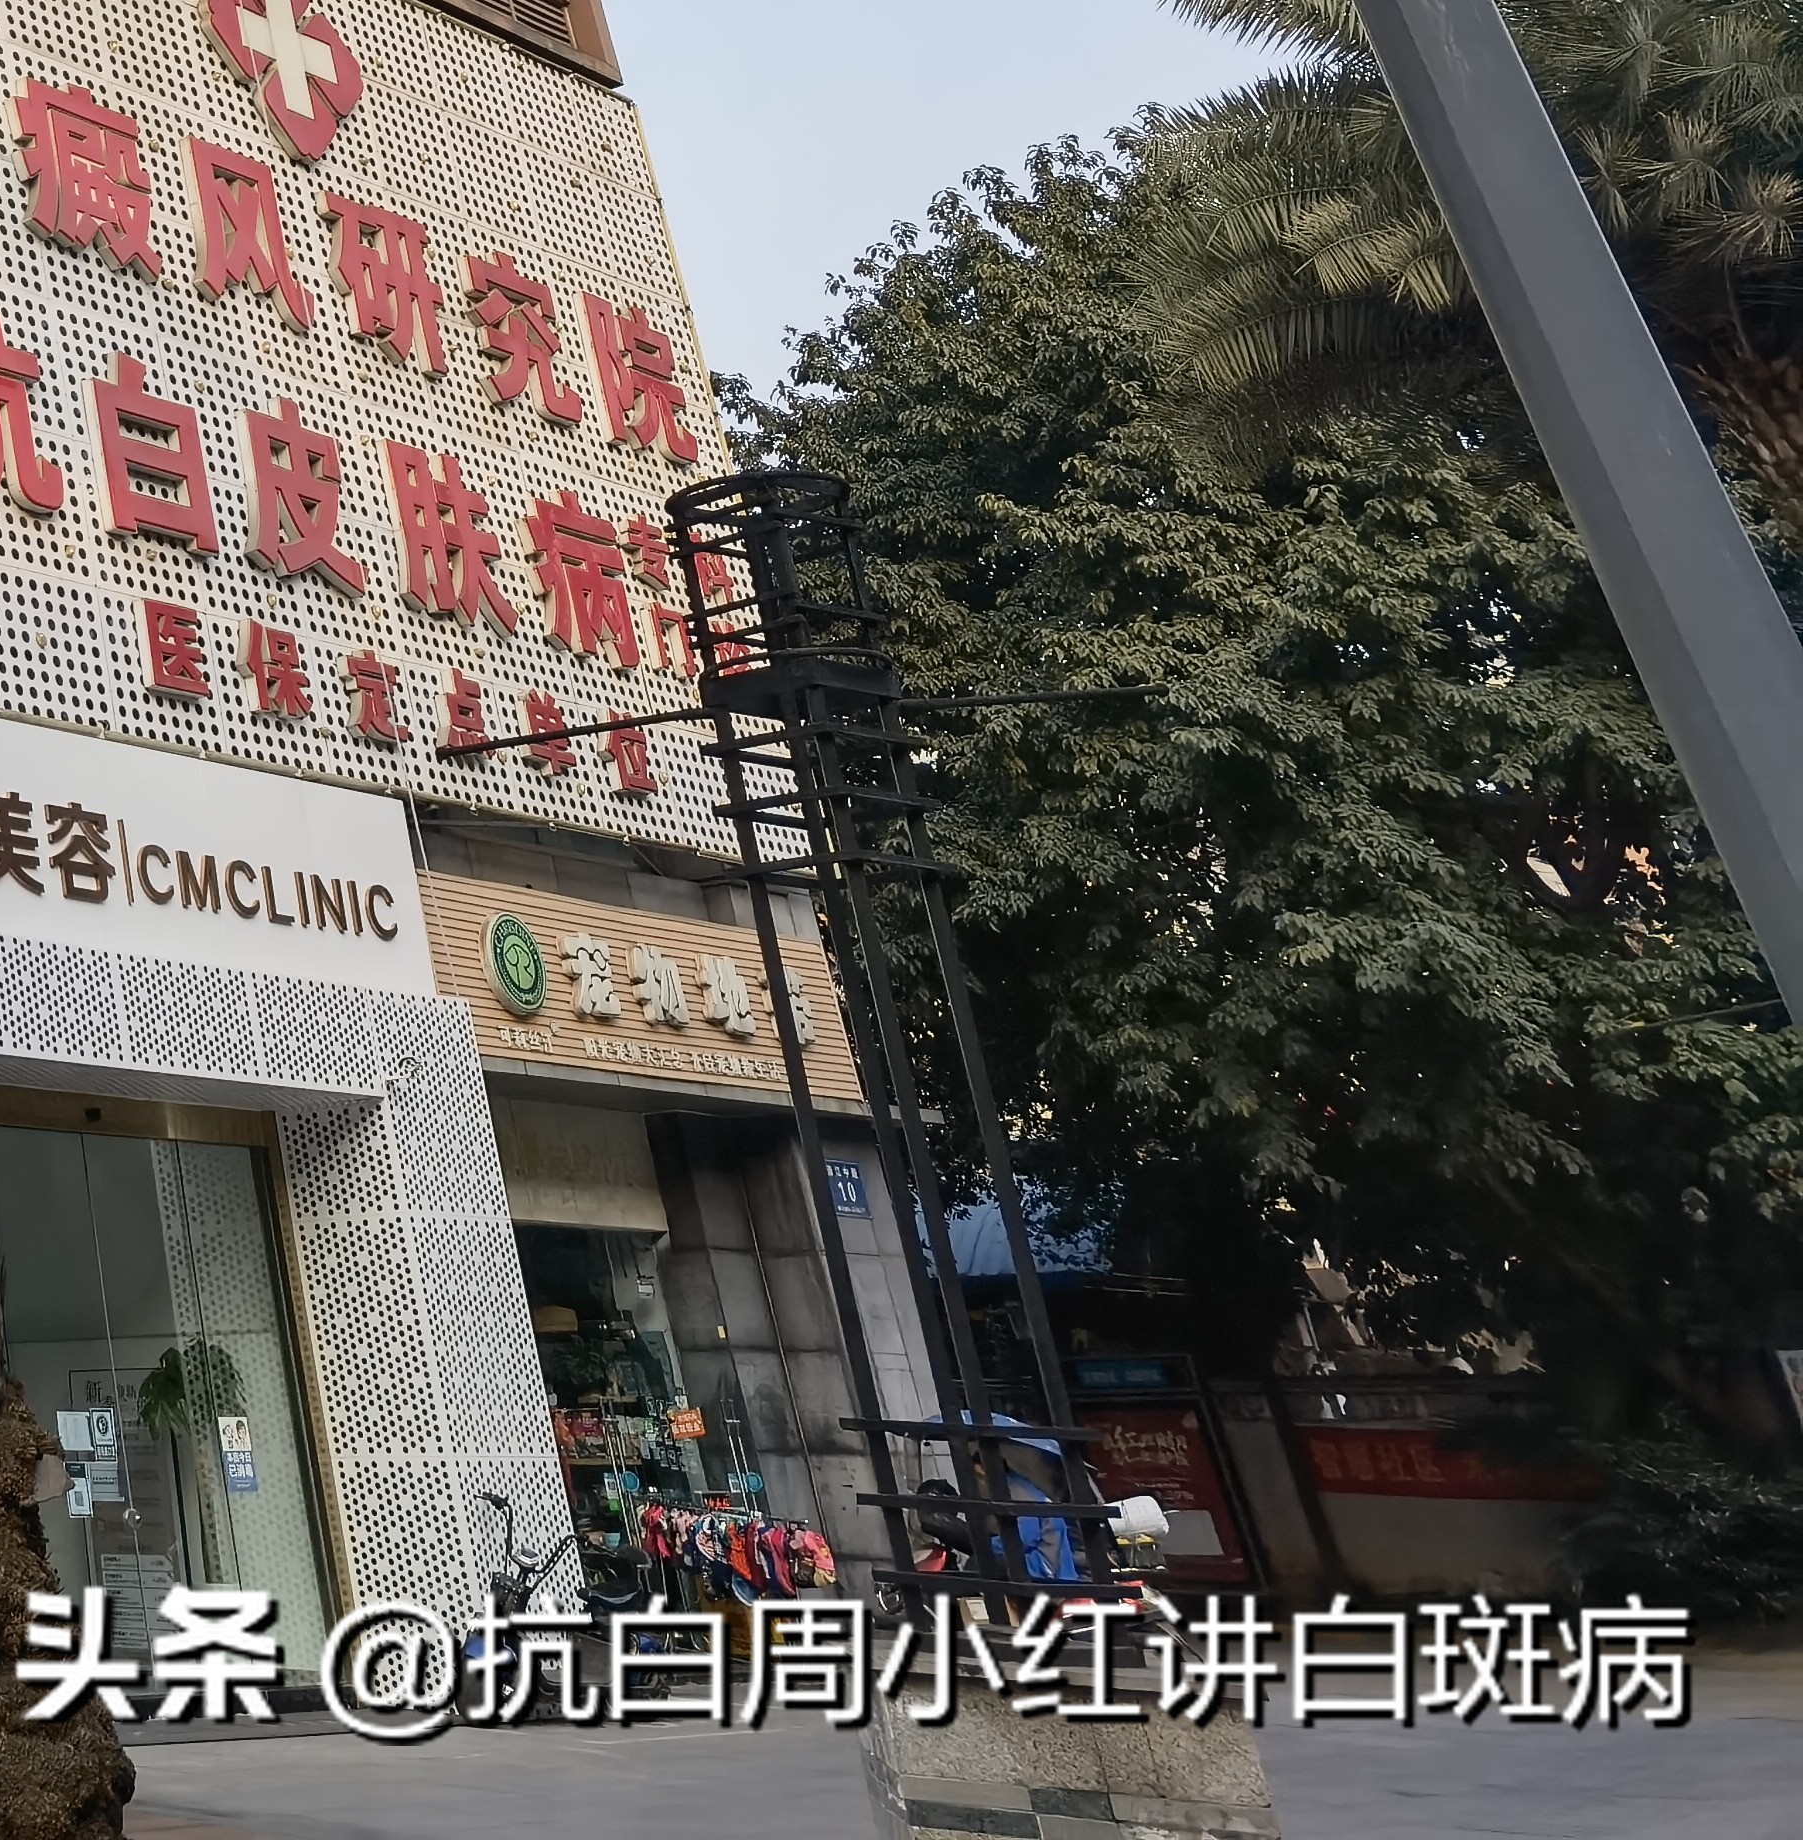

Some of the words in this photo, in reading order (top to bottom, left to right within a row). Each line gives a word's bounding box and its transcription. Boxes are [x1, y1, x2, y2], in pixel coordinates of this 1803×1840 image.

[135, 596, 658, 796] 医保定点单位
[136, 843, 399, 943] CMCLINIC
[837, 1181, 857, 1203] 10
